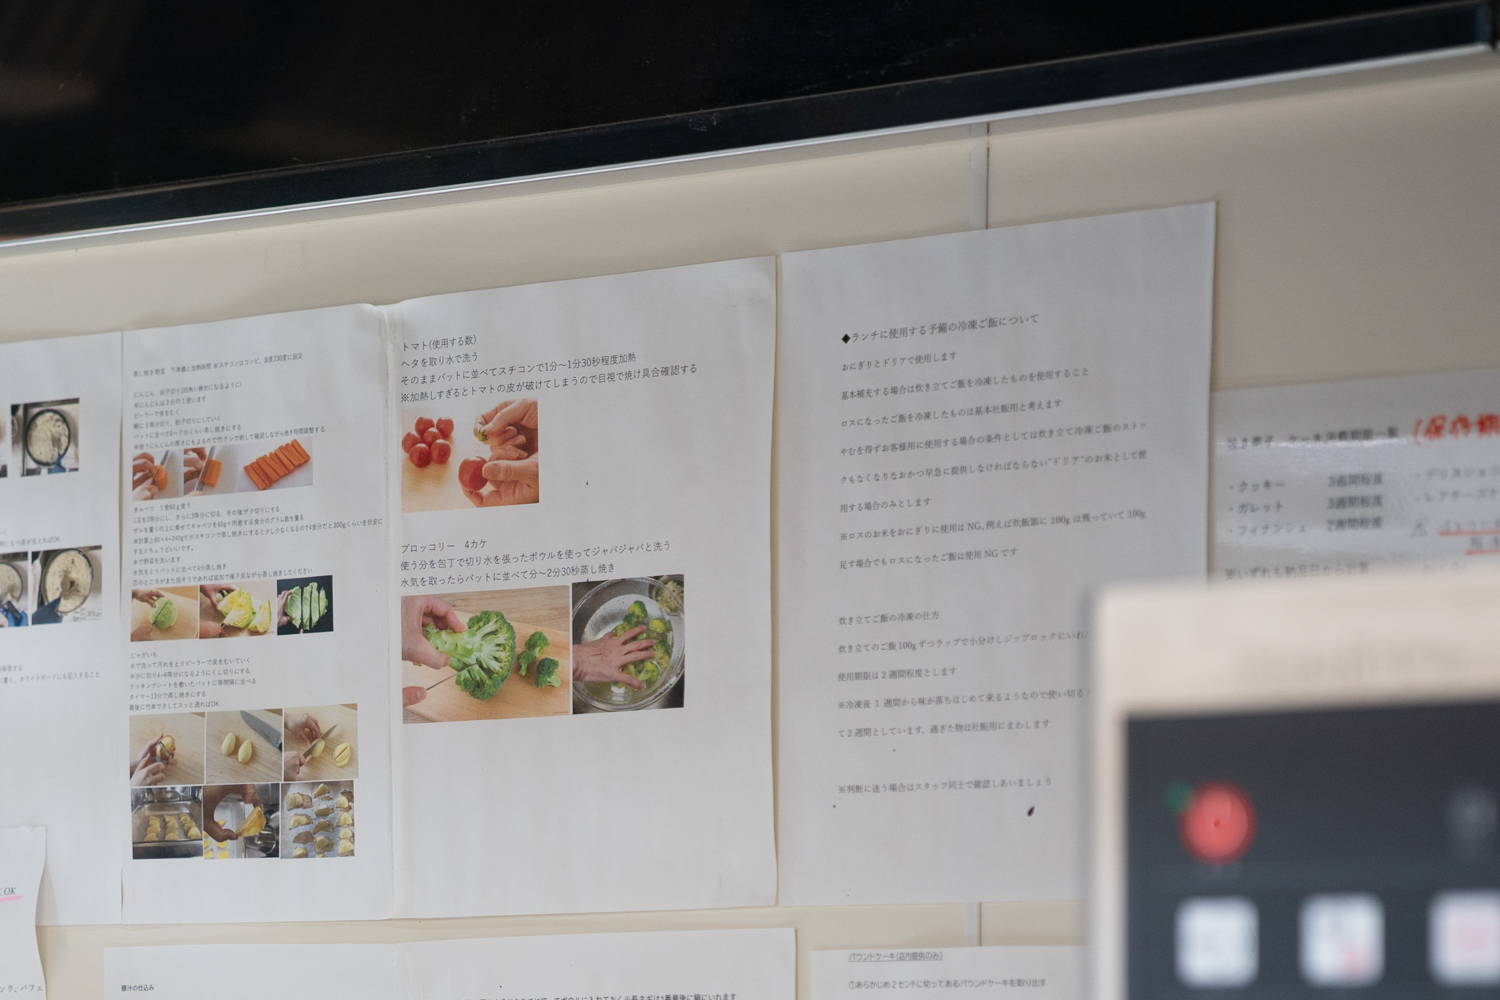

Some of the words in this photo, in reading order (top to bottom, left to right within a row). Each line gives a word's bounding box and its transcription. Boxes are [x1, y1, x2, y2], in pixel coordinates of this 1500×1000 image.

[401, 334, 477, 353] トマト(使用する数)
[401, 352, 479, 369] ヘタを取り水で洗う
[841, 351, 958, 371] おにぎりとドリアで使用します
[840, 497, 932, 514] 用する場合のみとします
[401, 541, 455, 556] ブロッコリー
[838, 611, 940, 627] 炊き立てご飯の冷凍の仕方
[130, 651, 158, 660] じゃがいも
[121, 984, 154, 992] 豚汁の仕込み
